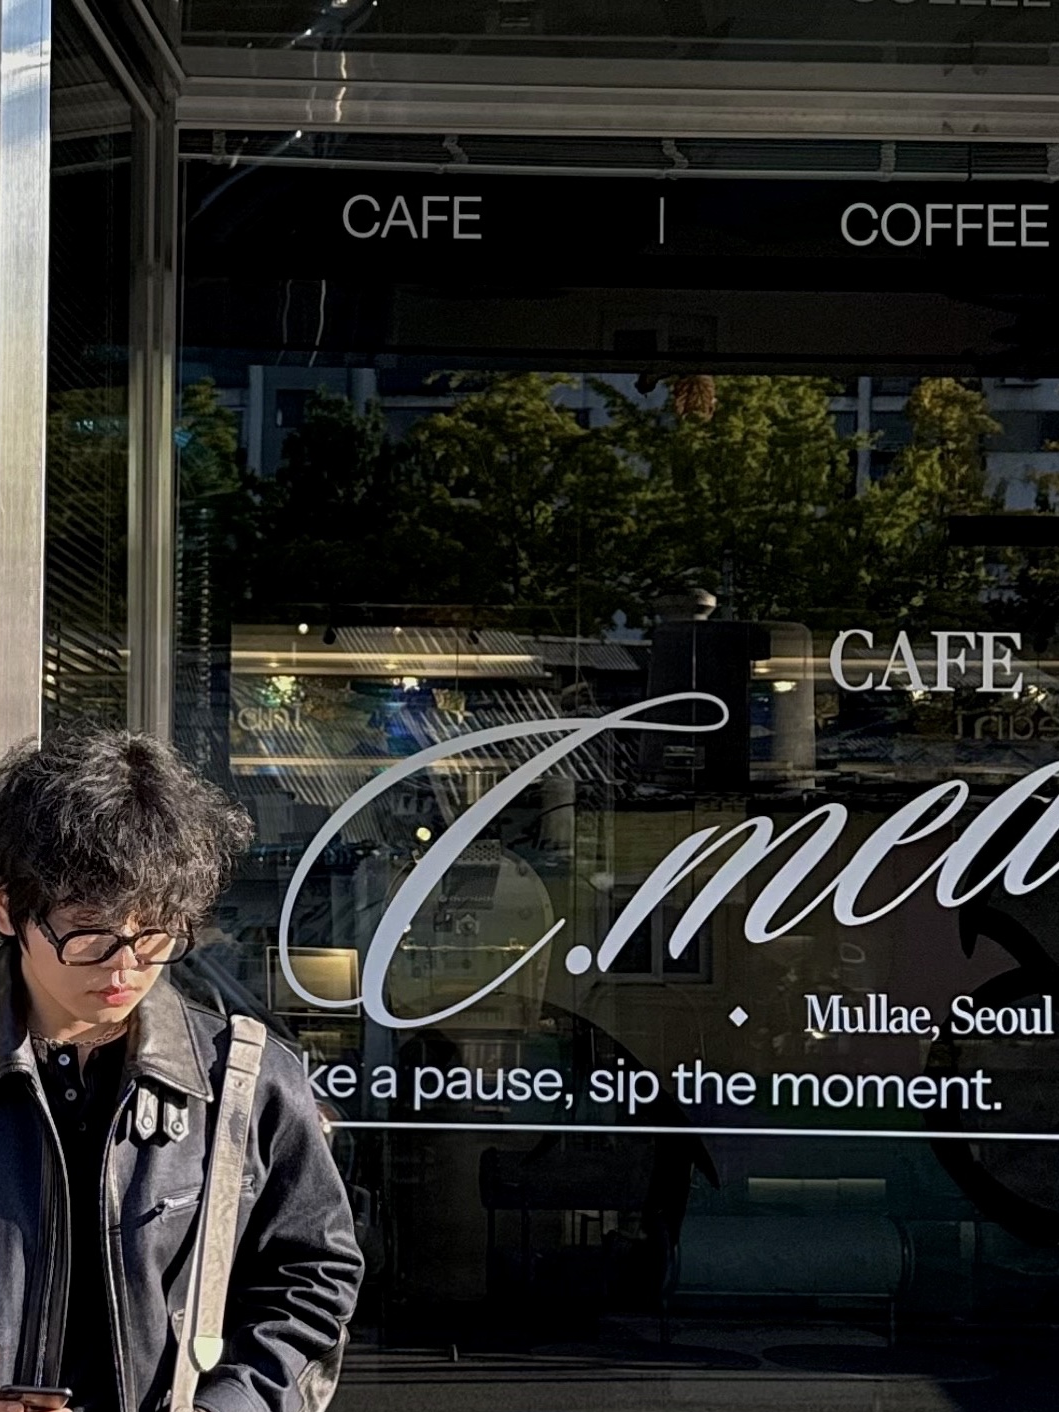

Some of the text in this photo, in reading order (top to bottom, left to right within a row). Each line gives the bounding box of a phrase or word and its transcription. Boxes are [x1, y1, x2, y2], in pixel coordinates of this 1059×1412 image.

[341, 194, 1050, 247] CAFE COFFEE
[829, 628, 1024, 692] CAFE
[804, 993, 1055, 1041] Mullae, Seoul
[302, 1051, 1002, 1114] ke a pause, sip the moment.
